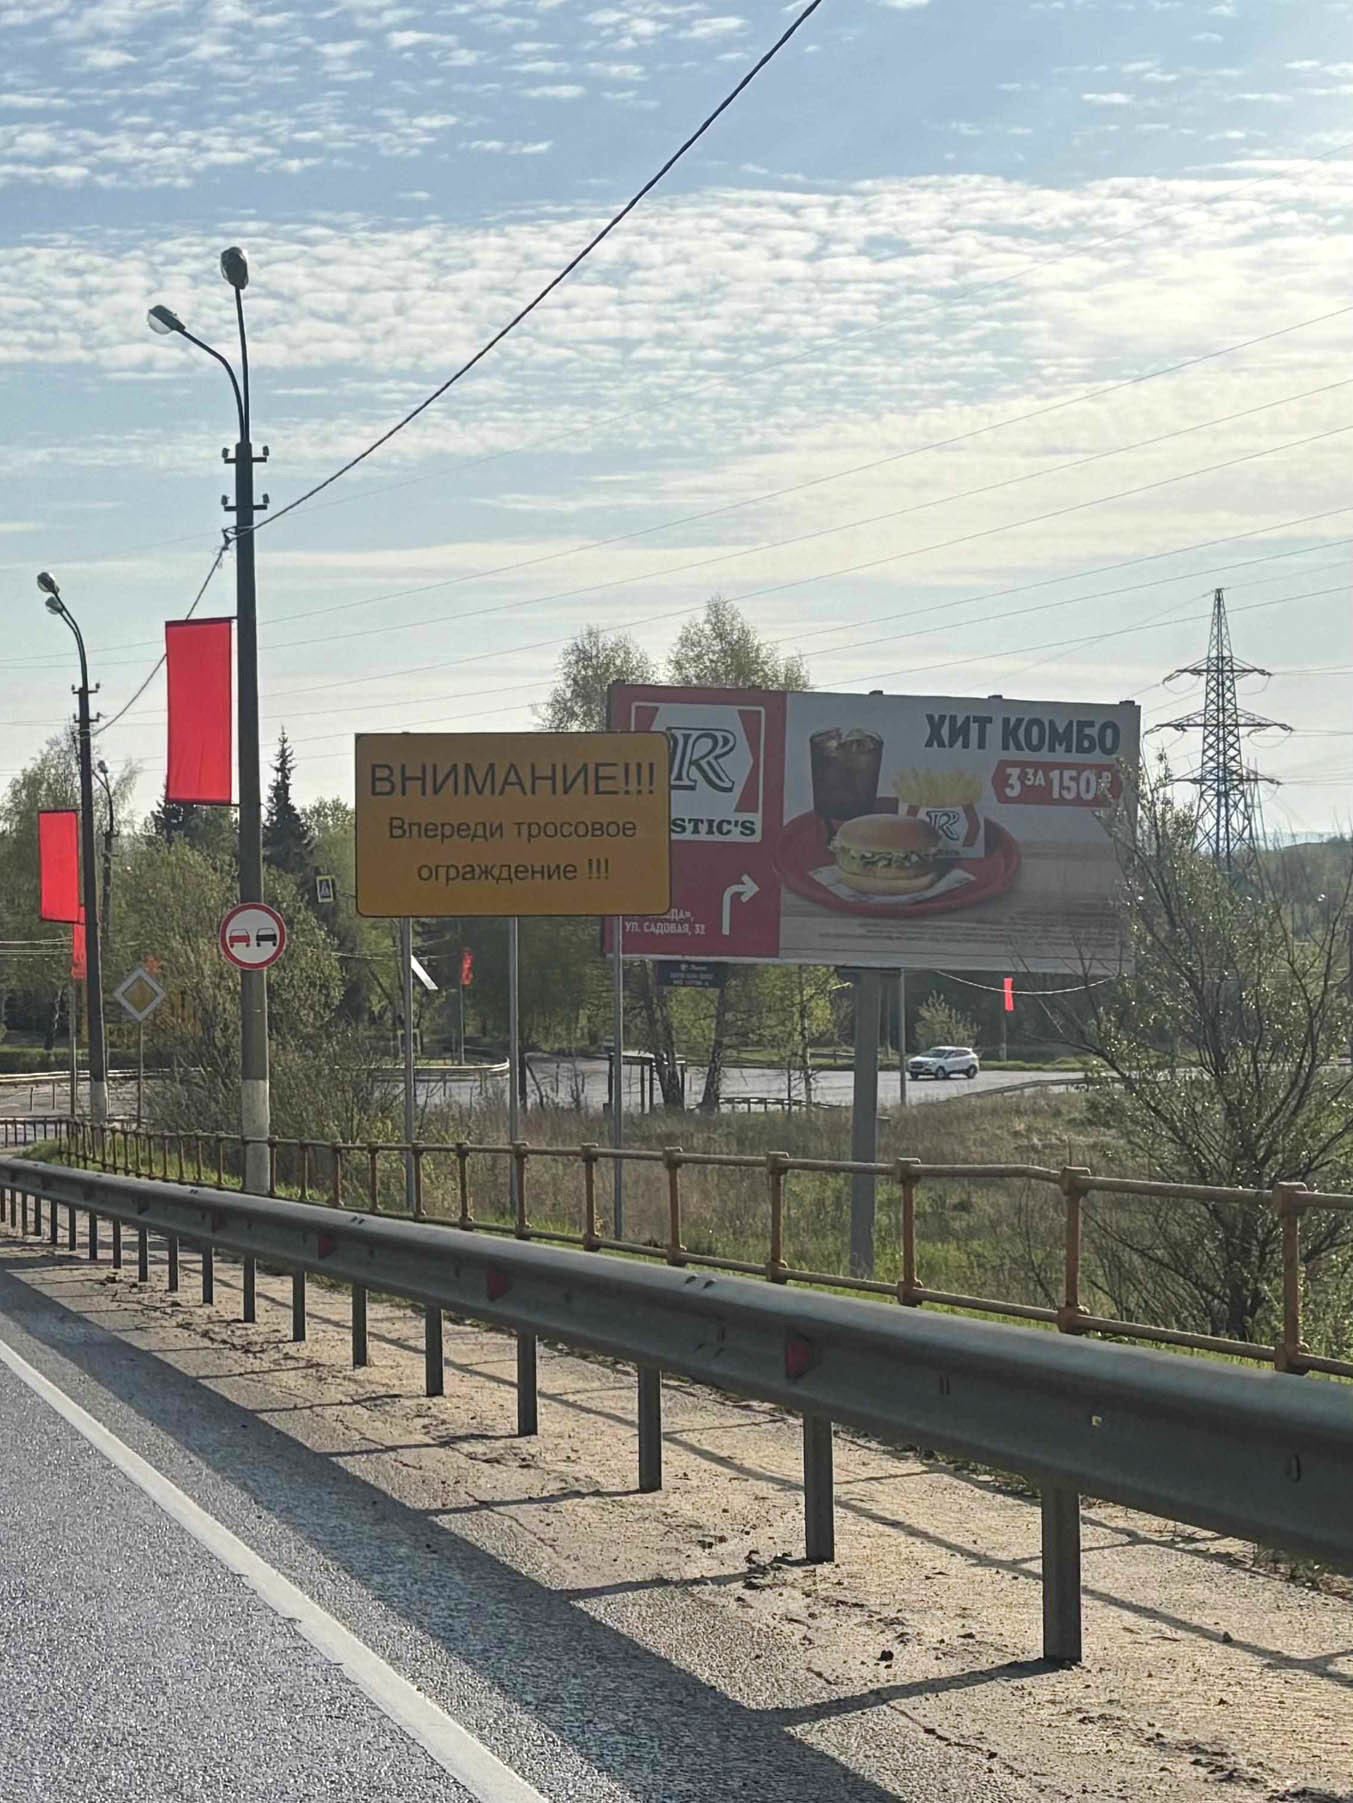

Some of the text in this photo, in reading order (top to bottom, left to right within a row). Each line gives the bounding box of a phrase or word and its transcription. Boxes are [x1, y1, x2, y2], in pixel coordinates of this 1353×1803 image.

[924, 713, 1121, 756] ХИТ КОМБО
[370, 762, 654, 796] ВНИМАНИЕ!!!
[1004, 768, 1022, 798] 3
[389, 817, 636, 843] Впереди тросовое
[417, 858, 609, 886] ограждение !!!
